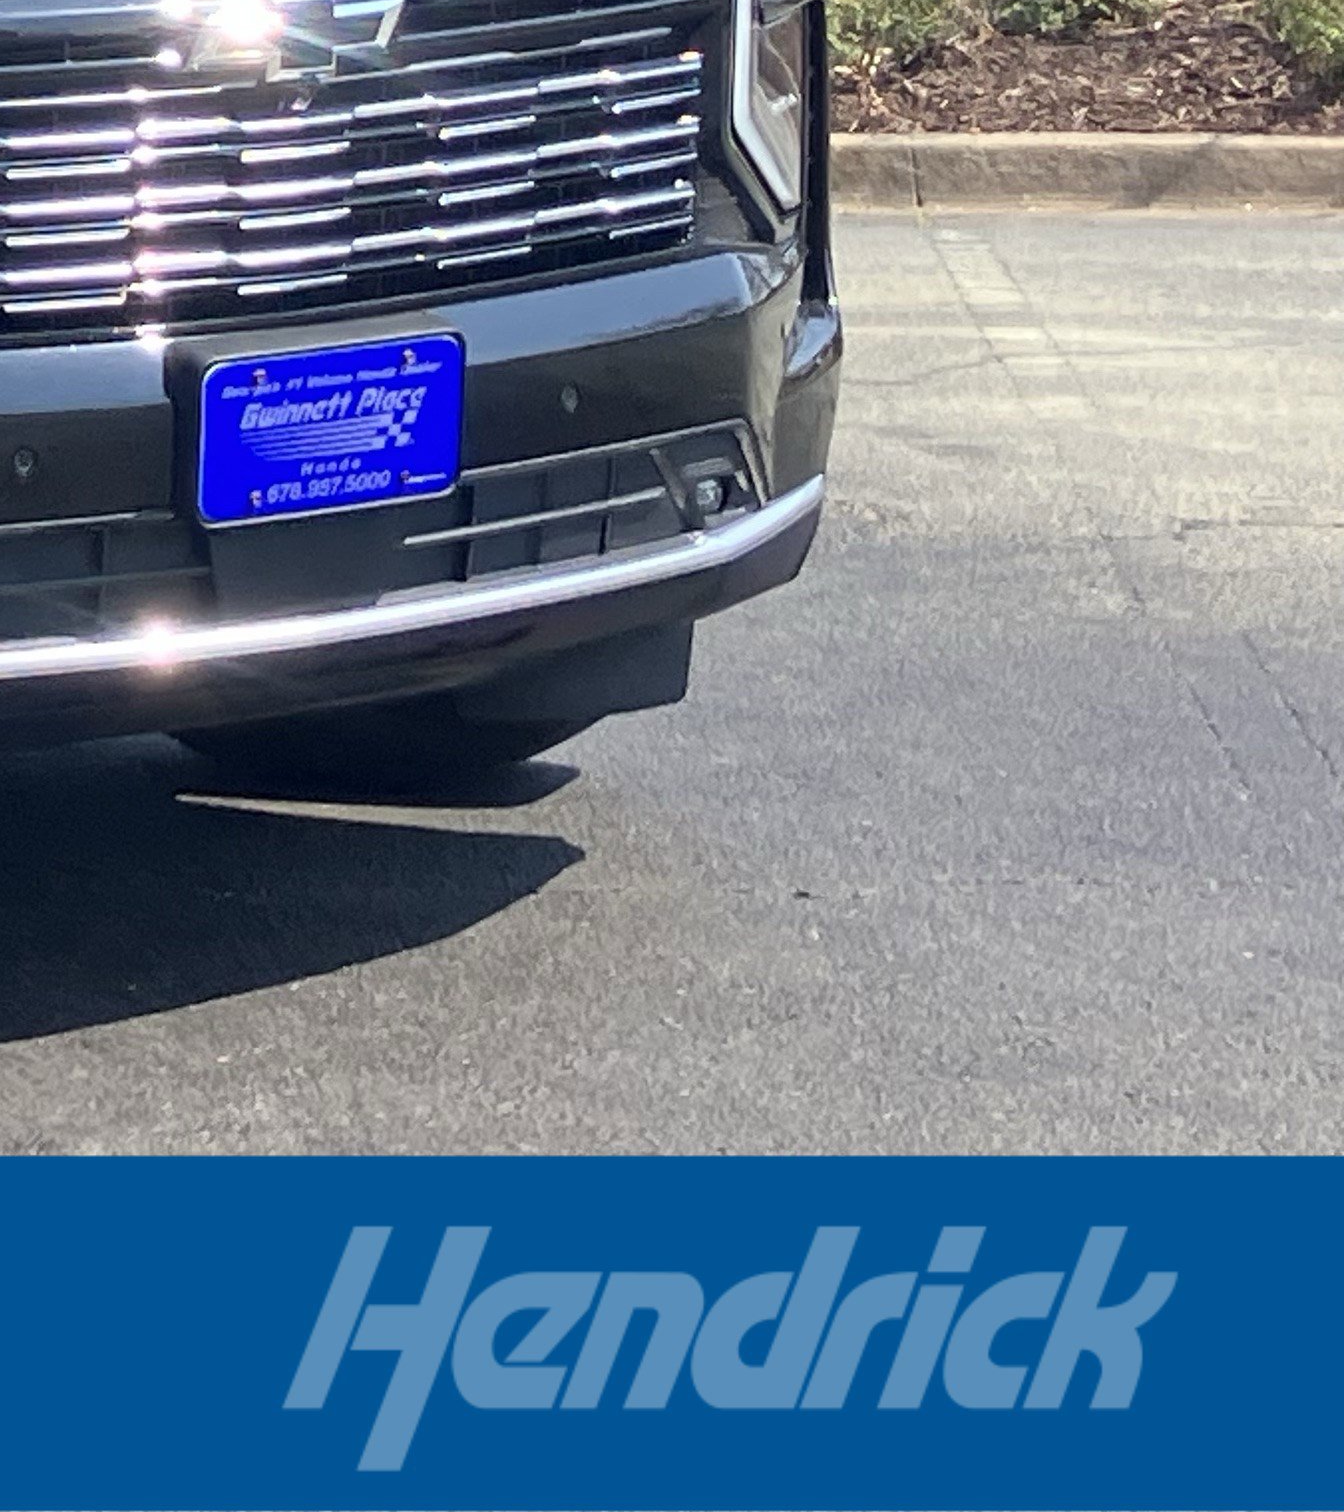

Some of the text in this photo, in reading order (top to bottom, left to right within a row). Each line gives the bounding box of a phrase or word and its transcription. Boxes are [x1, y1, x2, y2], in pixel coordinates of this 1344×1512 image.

[240, 386, 427, 430] Gwinnett Place
[300, 458, 361, 476] Honda
